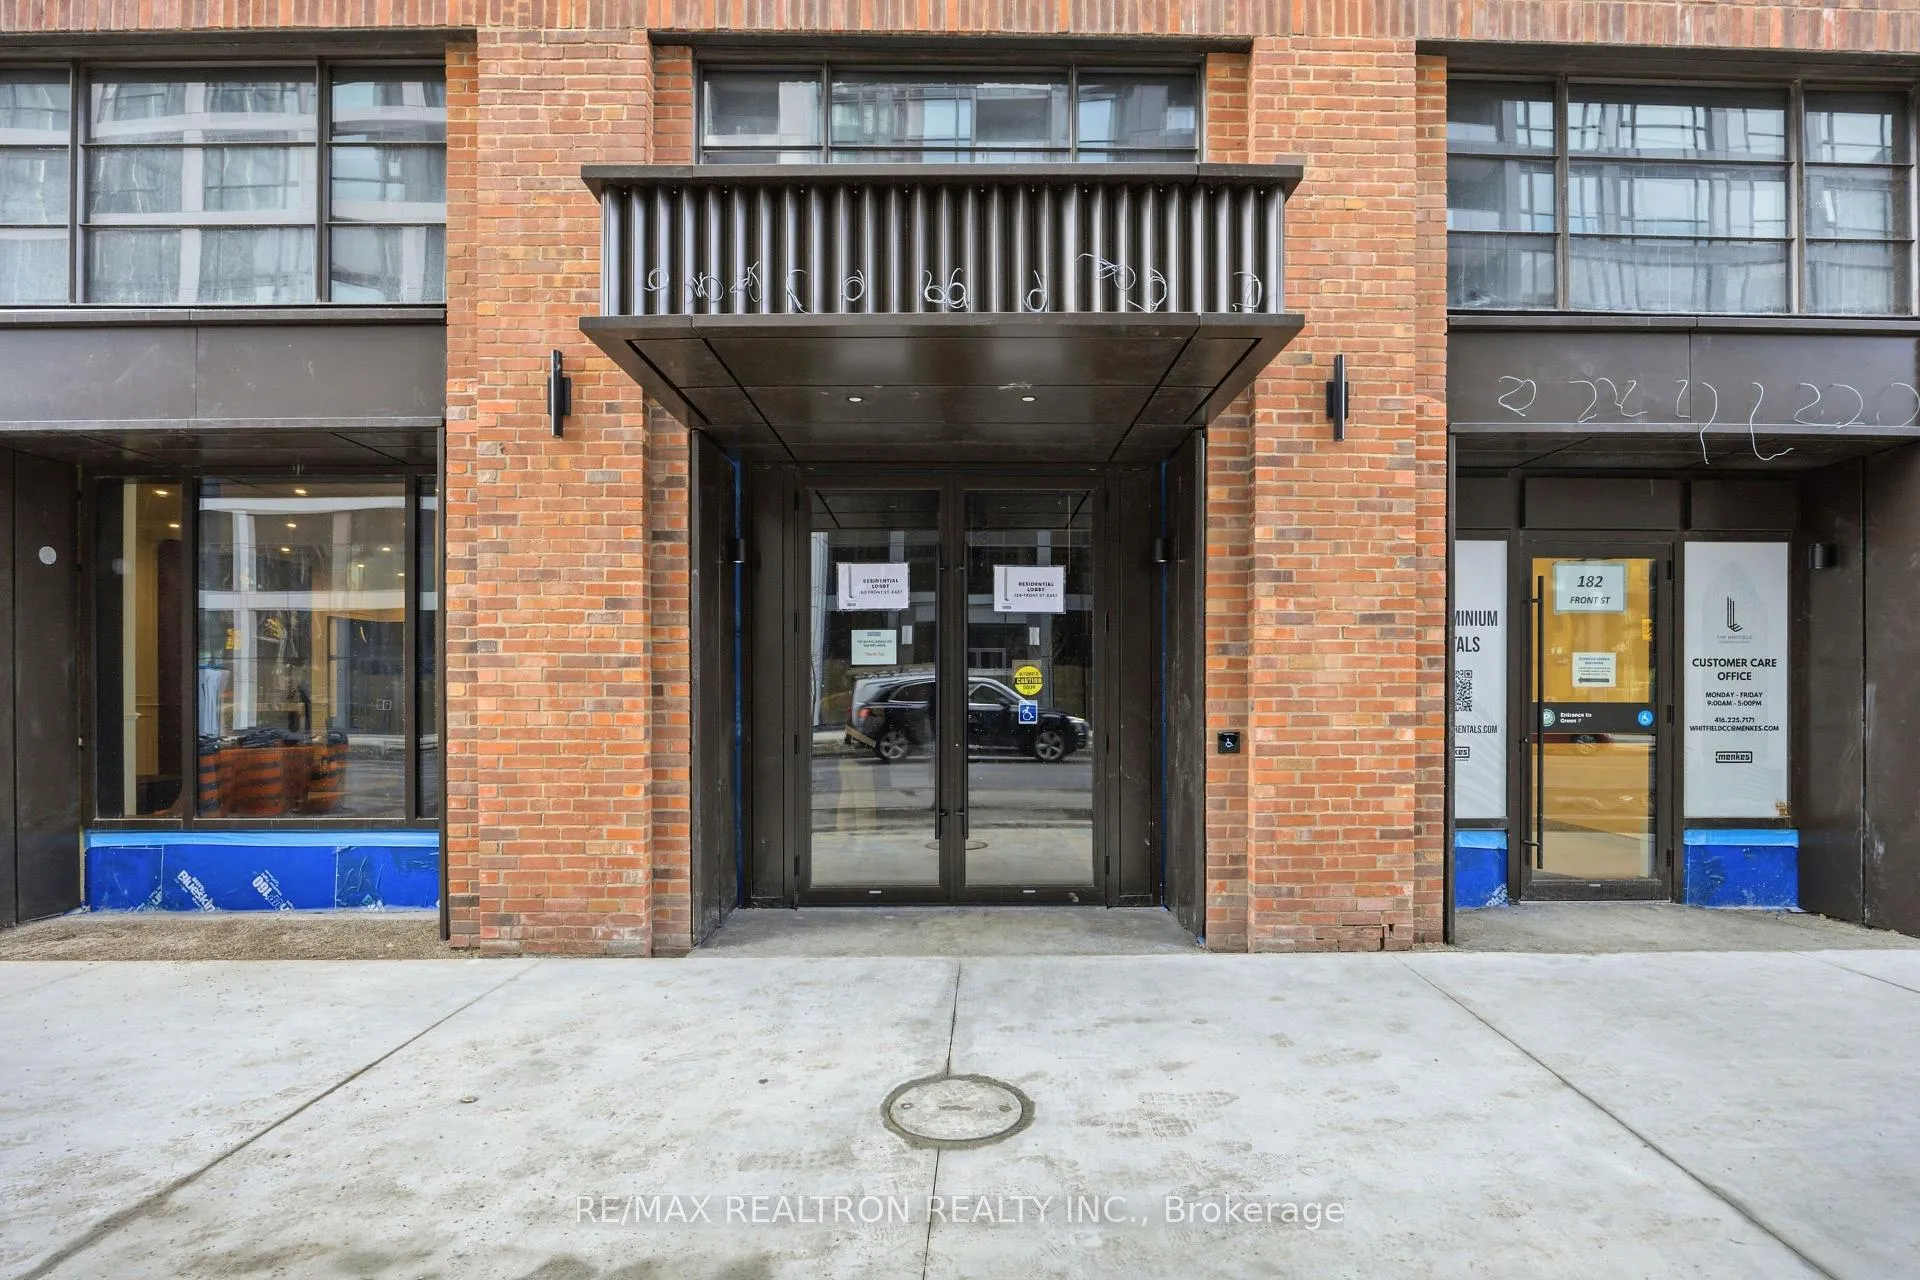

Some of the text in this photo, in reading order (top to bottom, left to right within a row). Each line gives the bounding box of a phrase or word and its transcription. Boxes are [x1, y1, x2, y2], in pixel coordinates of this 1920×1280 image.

[1577, 575, 1604, 588] 182
[1569, 596, 1611, 604] FRONT ST
[1692, 658, 1777, 668] CUSTOMER CARE
[1717, 671, 1752, 681] OFFICE
[177, 870, 216, 912] Blueskin
